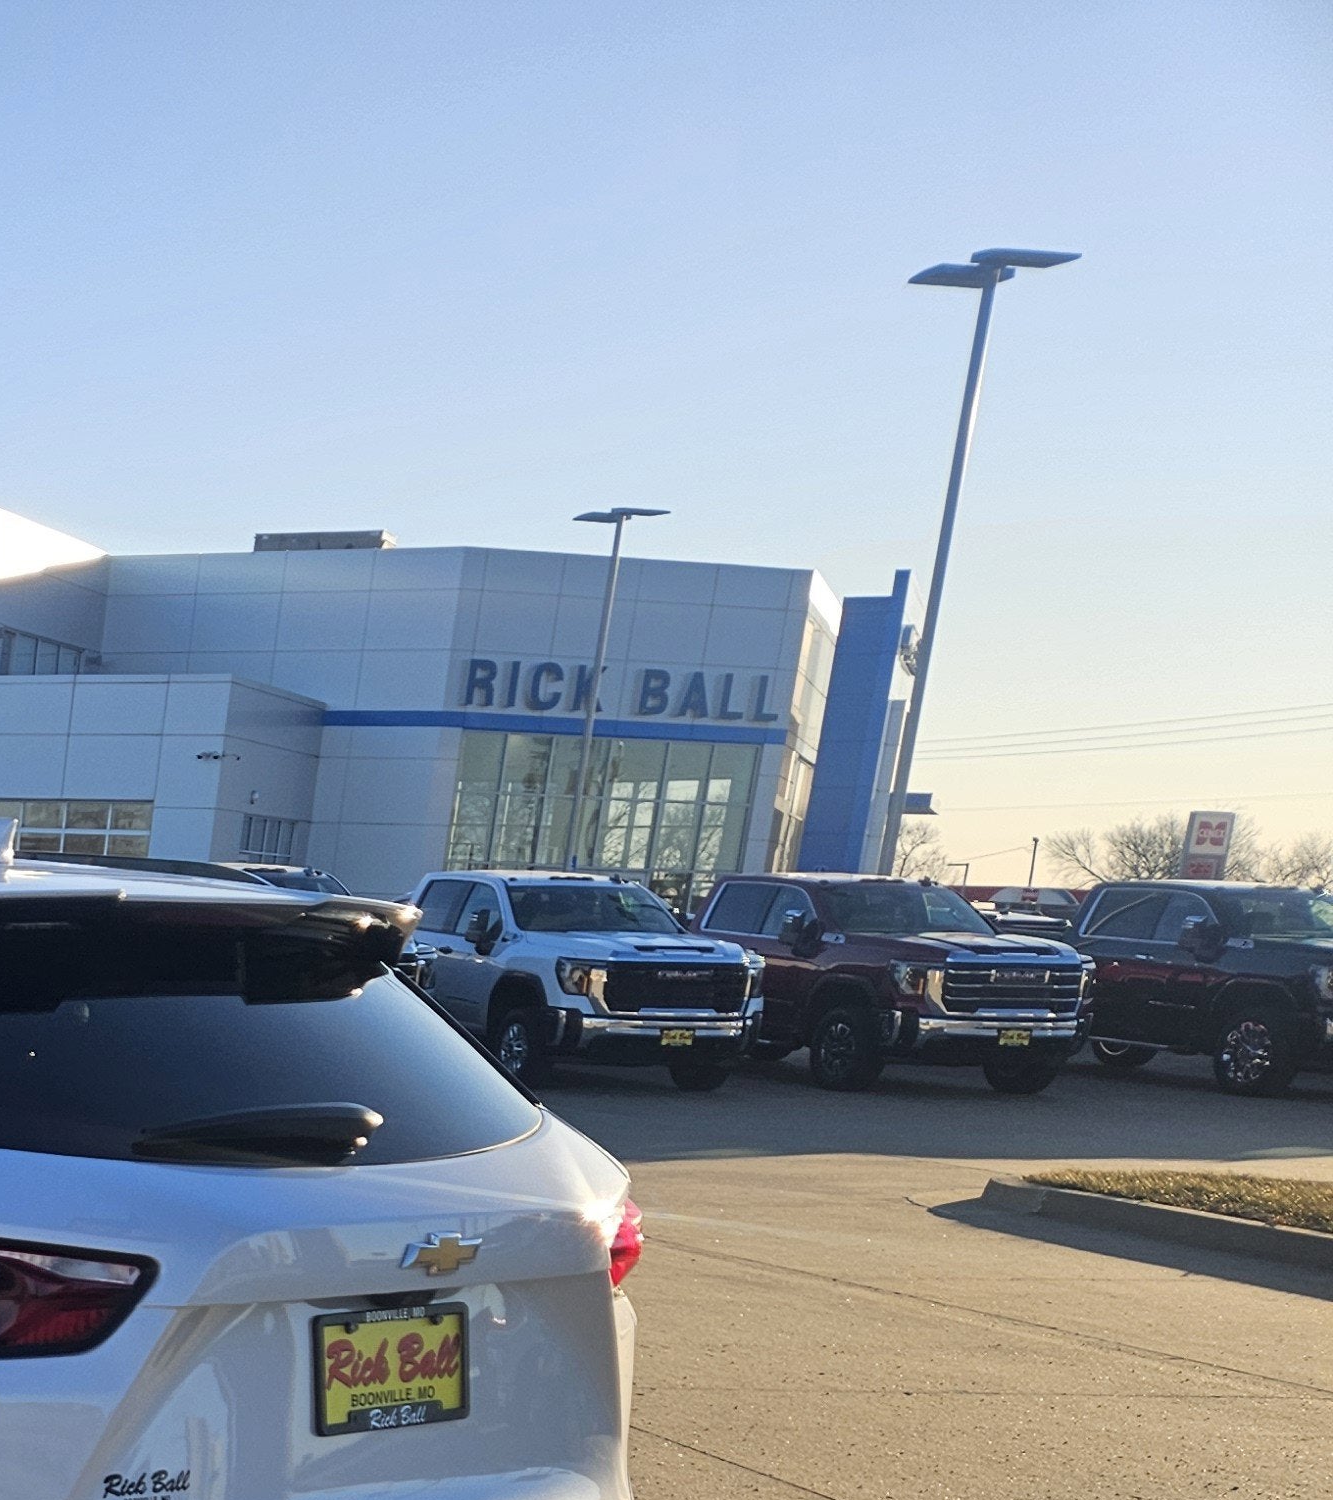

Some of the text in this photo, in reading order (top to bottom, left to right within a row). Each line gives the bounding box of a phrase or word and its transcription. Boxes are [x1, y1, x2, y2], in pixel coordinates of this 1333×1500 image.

[464, 658, 779, 723] RICK BALL
[412, 1306, 425, 1317] MO
[327, 1332, 461, 1389] Rick Ball
[418, 1385, 435, 1400] MO
[369, 1405, 427, 1429] Rick Ball
[102, 1469, 191, 1499] Rick Ball
